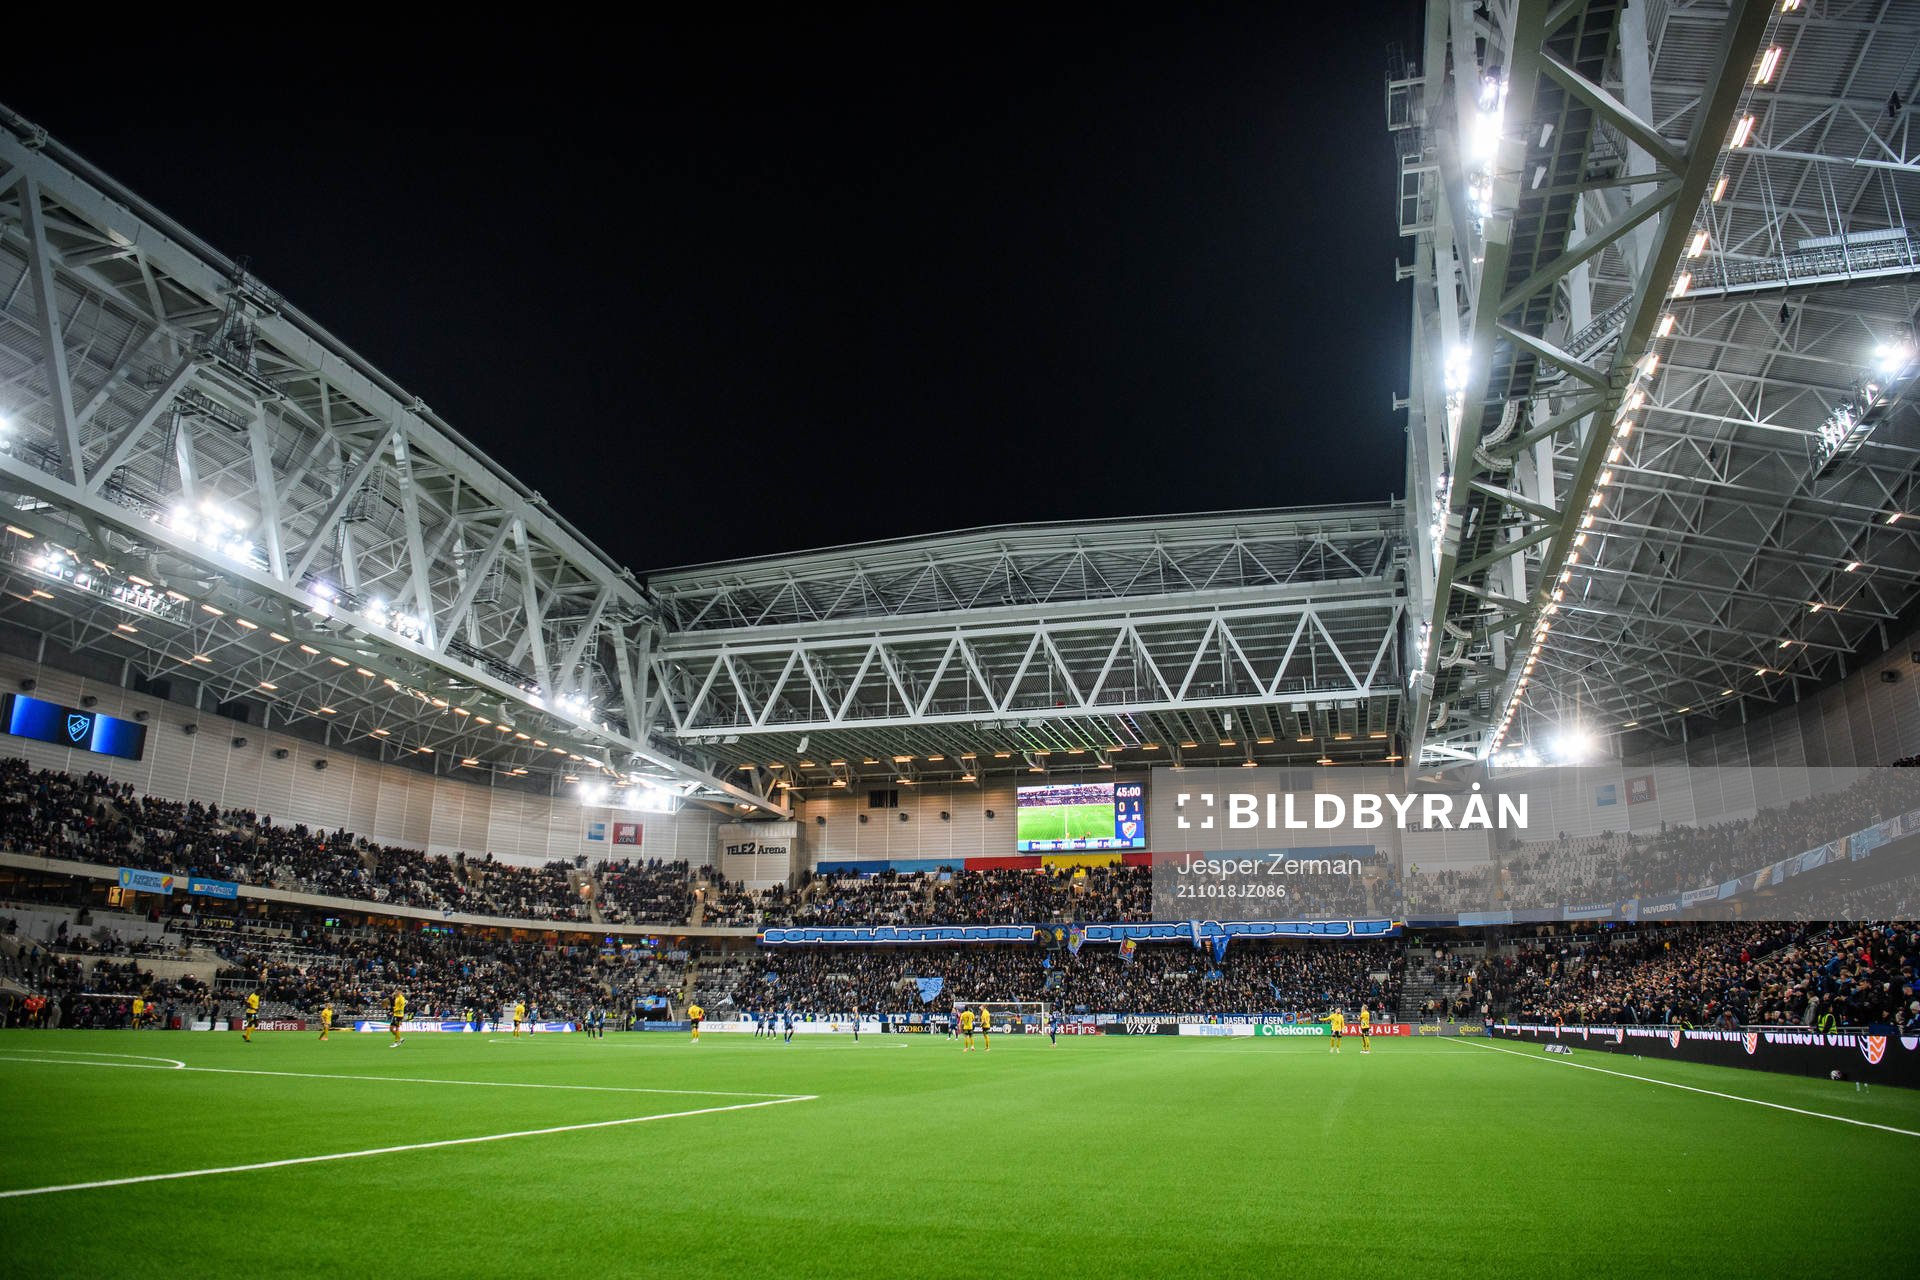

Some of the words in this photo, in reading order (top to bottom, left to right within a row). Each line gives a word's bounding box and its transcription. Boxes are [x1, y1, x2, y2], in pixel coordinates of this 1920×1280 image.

[1116, 786, 1141, 798] 45:00
[1118, 802, 1126, 812] 0
[1133, 801, 1139, 812] 1
[726, 842, 755, 855] TELE2
[757, 845, 787, 855] Arena
[1351, 919, 1392, 936] IF
[275, 1020, 298, 1031] Finans
[1125, 1023, 1159, 1035] V/S/B
[1274, 1024, 1324, 1035] Rekomo
